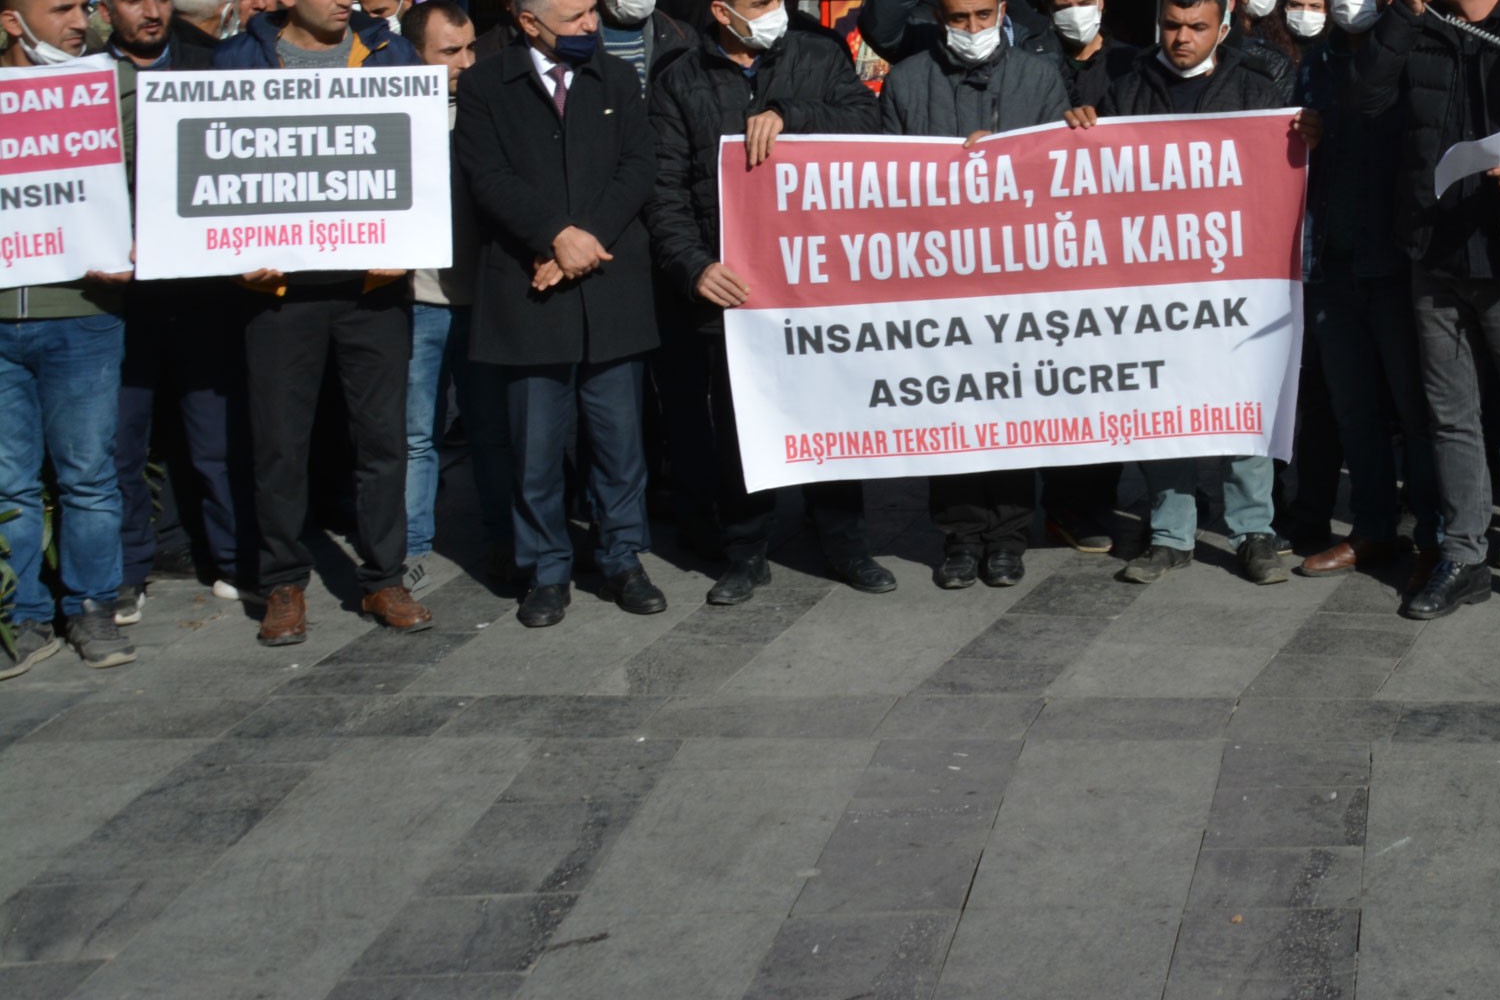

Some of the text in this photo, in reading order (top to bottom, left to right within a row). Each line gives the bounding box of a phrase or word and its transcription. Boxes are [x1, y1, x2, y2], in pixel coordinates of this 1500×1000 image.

[0, 82, 110, 115] DAN AZ
[145, 73, 440, 103] ZAMLAR GERİ ALINSIN!
[0, 127, 119, 161] DAN ÇOK
[205, 122, 377, 160] ÜCRETLER
[192, 169, 397, 206] ARTIRILSIN!
[775, 138, 1243, 211] PAHALILIĞA, ZAMLARA
[0, 226, 65, 268] ÇİLERİ
[206, 218, 387, 257] BAŞPINAR İŞÇİLERİ
[778, 209, 1244, 285] VE YOKSULLUĞA KARŞI
[784, 295, 1249, 356] İNSANCA YAŞAYACAK
[868, 359, 1167, 408] ASGARİ ÜCRET
[785, 401, 1263, 467] BAŞPINAR TEKSTİL VE DOKUMA İŞÇİLERİ BİRLİĞİ
